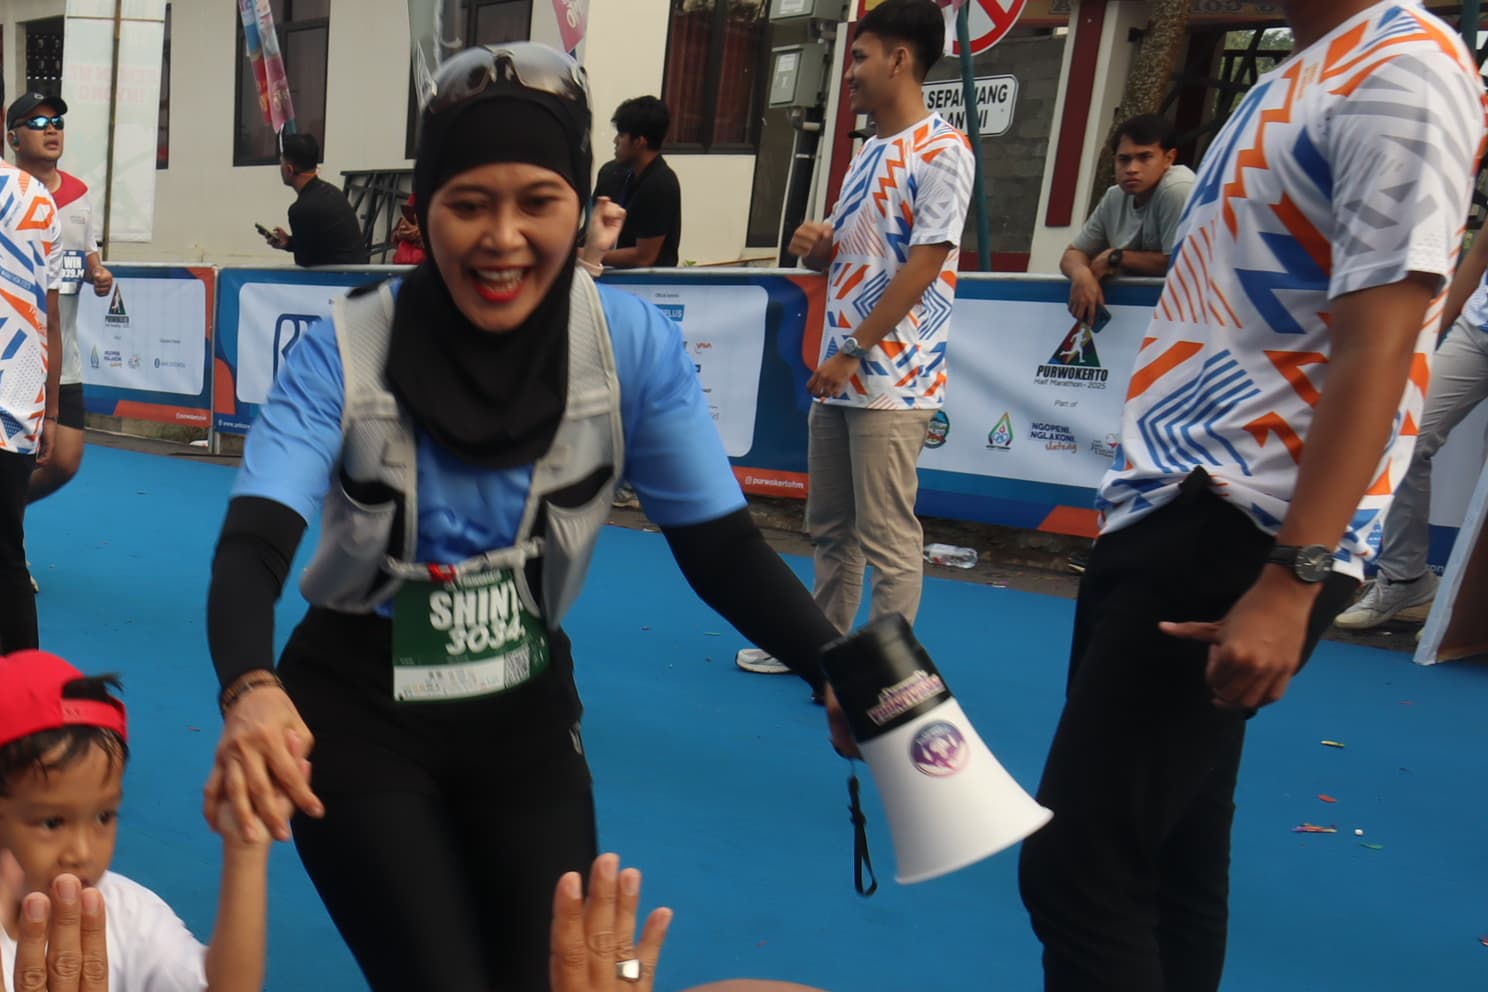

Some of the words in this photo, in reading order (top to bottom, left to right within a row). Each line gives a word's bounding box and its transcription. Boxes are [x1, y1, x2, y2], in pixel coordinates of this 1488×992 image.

[927, 84, 1008, 109] SEPAANG
[664, 308, 682, 318] PLUS
[1036, 365, 1109, 382] PURWOKERTO
